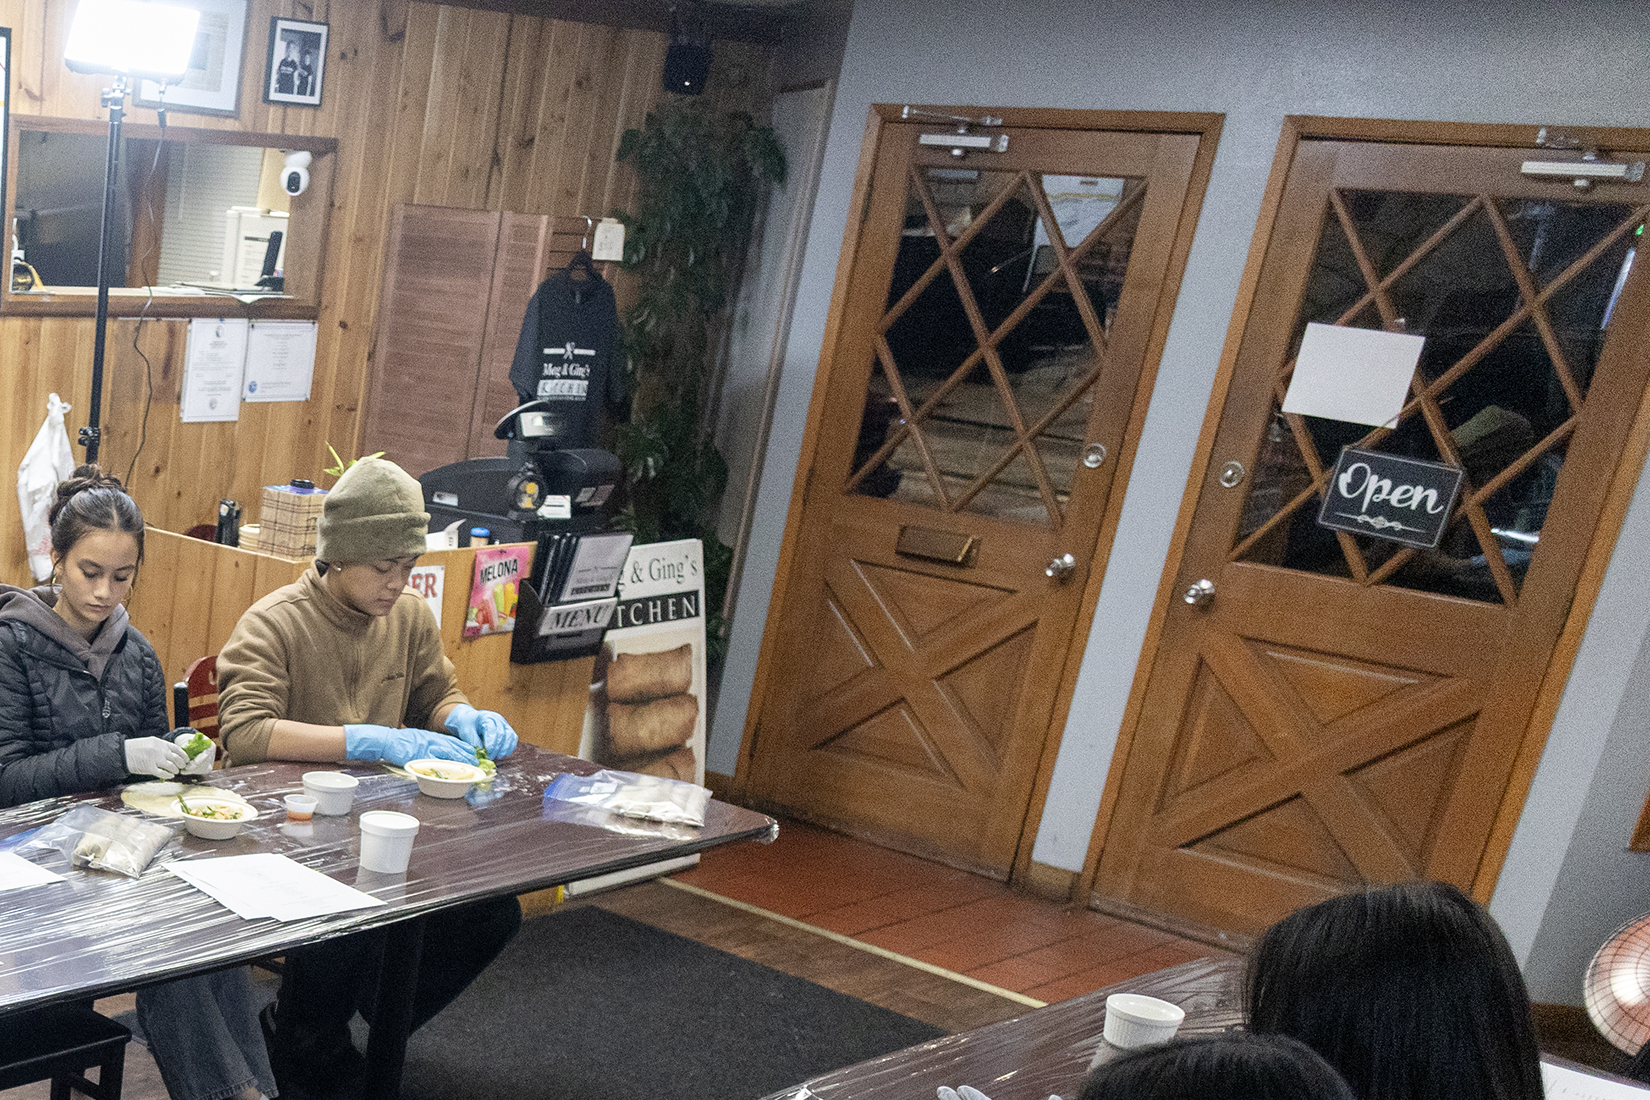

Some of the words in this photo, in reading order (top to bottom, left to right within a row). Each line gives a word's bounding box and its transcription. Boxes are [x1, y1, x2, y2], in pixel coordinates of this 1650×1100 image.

[1338, 462, 1444, 514] Open
[480, 559, 518, 584] MELONA
[631, 561, 644, 585] &
[650, 554, 699, 585] Ging's
[411, 573, 437, 598] ER
[550, 604, 611, 630] MENU
[616, 594, 696, 629] TCHEN
